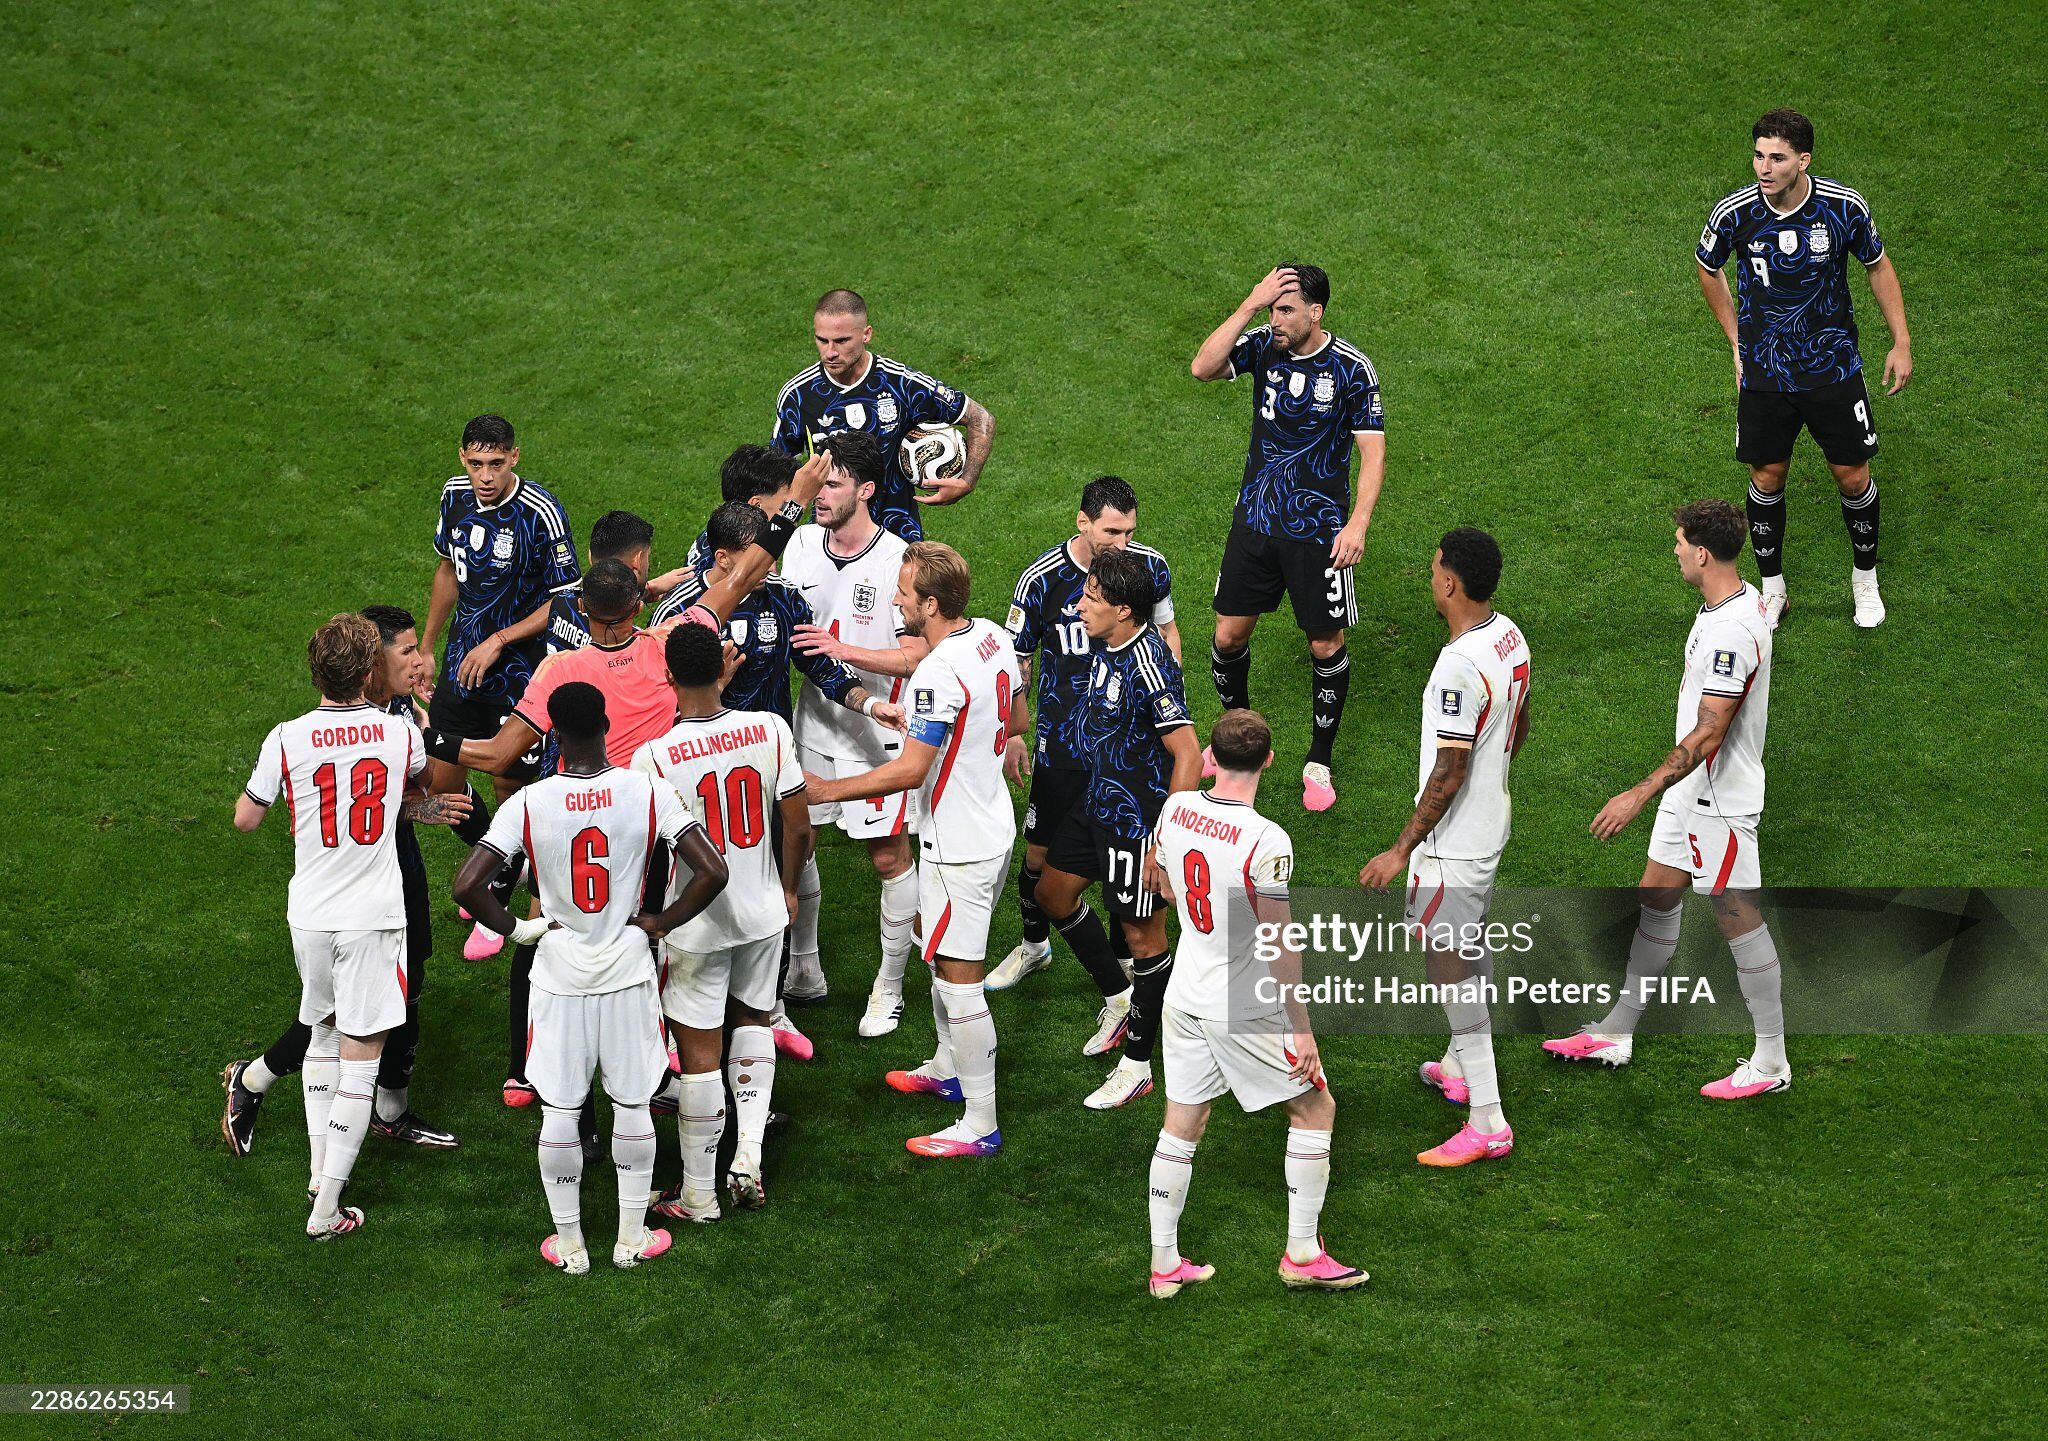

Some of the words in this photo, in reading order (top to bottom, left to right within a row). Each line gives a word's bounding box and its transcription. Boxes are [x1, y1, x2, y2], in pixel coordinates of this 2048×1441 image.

[1751, 257, 1770, 287] 9
[1262, 385, 1277, 421] 3
[1853, 399, 1869, 431] 9
[1324, 567, 1343, 603] 3
[975, 632, 1001, 663] KANE
[1055, 621, 1090, 656] 10
[1493, 627, 1522, 662] ROGERS
[608, 656, 634, 668] ELFATH
[993, 669, 1013, 757] 9
[311, 723, 385, 748] GORDON
[667, 724, 769, 766] BELLINGHAM
[312, 757, 389, 848] 18
[565, 788, 613, 813] GUÉHI
[696, 764, 765, 855] 10
[1169, 805, 1243, 846] ANDERSON
[1107, 846, 1134, 888] 17
[1688, 832, 1703, 869] 5
[571, 825, 610, 914] 6
[1183, 848, 1215, 936] 8
[308, 1084, 330, 1093] ENG
[328, 1119, 350, 1133] ENG
[556, 1175, 577, 1185] ENG
[1151, 1187, 1170, 1199] ENG
[1287, 1186, 1298, 1195] NG
